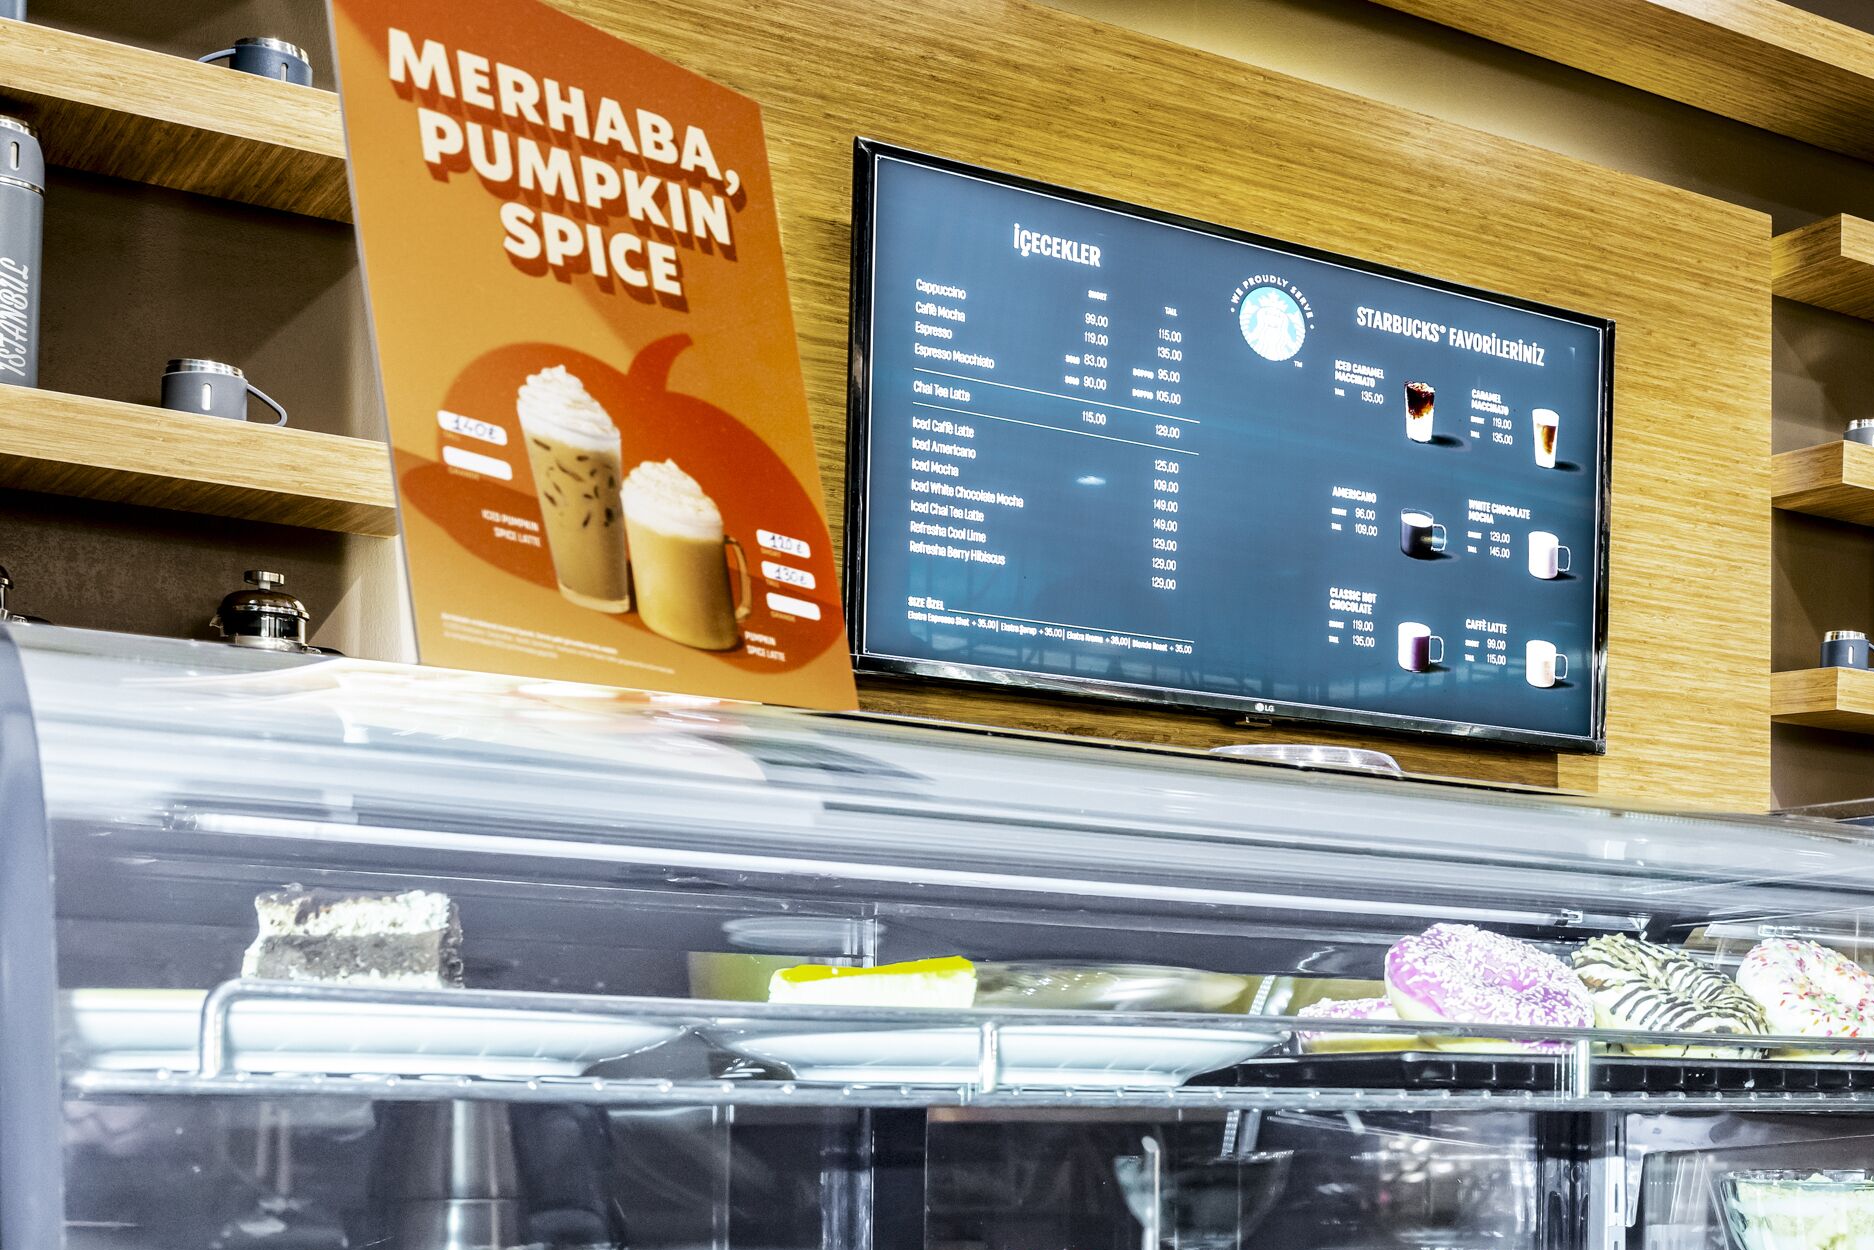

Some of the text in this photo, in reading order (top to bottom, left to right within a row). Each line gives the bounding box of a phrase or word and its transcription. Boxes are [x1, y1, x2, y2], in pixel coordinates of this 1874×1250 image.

[387, 27, 742, 197] MERHABA,
[416, 107, 734, 246] PUMPKIN
[499, 202, 682, 296] SPICE
[1013, 223, 1101, 267] İÇECEKLER
[916, 278, 966, 300] Cappuccino
[1231, 274, 1314, 319] WE PROUDLY SERVE
[937, 305, 966, 322] Mocha
[915, 320, 952, 339] Espresso
[1085, 312, 1182, 343] 99,00 115,00
[914, 342, 995, 369] Espresso Macchiato
[1449, 327, 1545, 367] FAVORİLERİNİZ
[913, 380, 971, 402] Chai Tea Latte
[912, 416, 931, 430] Iced
[954, 423, 974, 438] Latte
[912, 437, 976, 459] Iced Americano
[911, 457, 959, 477] Iced Mocha
[911, 478, 1024, 508] Iced White Chocolate Mocha
[1332, 485, 1377, 504] AMERICANO
[910, 499, 985, 522] Iced Chai Tea Latte
[1491, 503, 1531, 520] CHOCOLATE
[910, 520, 987, 543] Refresha Cool Lime
[909, 540, 1006, 565] Refresha Berry Hibiscus
[1329, 598, 1372, 615] CHOCOLATE
[1487, 621, 1507, 634] LATTE
[1264, 704, 1275, 712] LG
